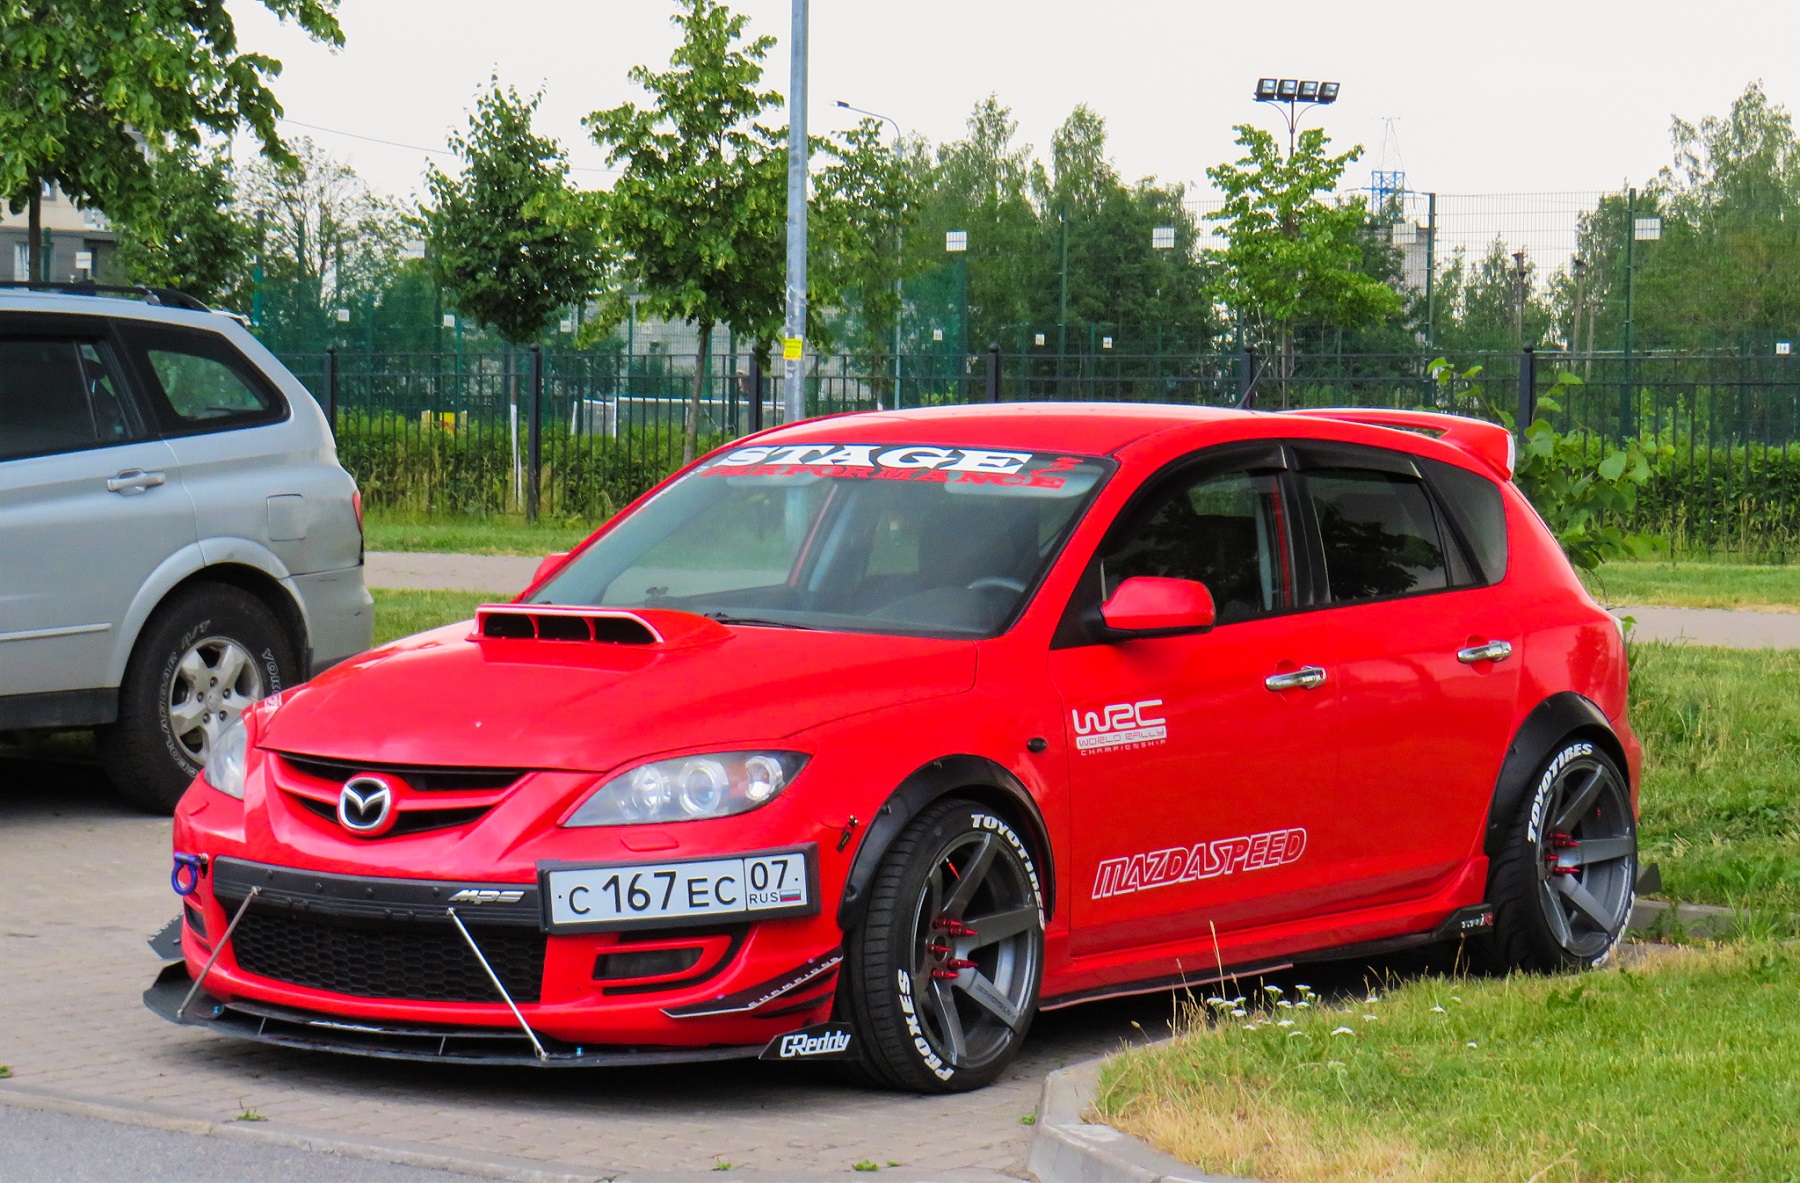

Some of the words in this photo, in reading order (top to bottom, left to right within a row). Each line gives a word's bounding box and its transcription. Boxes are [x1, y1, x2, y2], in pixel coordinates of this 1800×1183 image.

[706, 445, 1034, 474] STAGE
[699, 464, 1067, 490] PERFORMANCE
[1072, 699, 1166, 734] WRC
[1078, 734, 1122, 748] WORLD
[1125, 727, 1165, 741] RALLY
[1080, 739, 1166, 756] CHAMPIONSHIP
[750, 859, 789, 891] 07
[1091, 827, 1307, 900] MAZDASPEED
[448, 889, 525, 905] MPS
[601, 871, 677, 913] 167
[749, 891, 779, 904] RUS
[898, 969, 955, 1082] PROXES
[780, 1030, 851, 1058] GReddy
